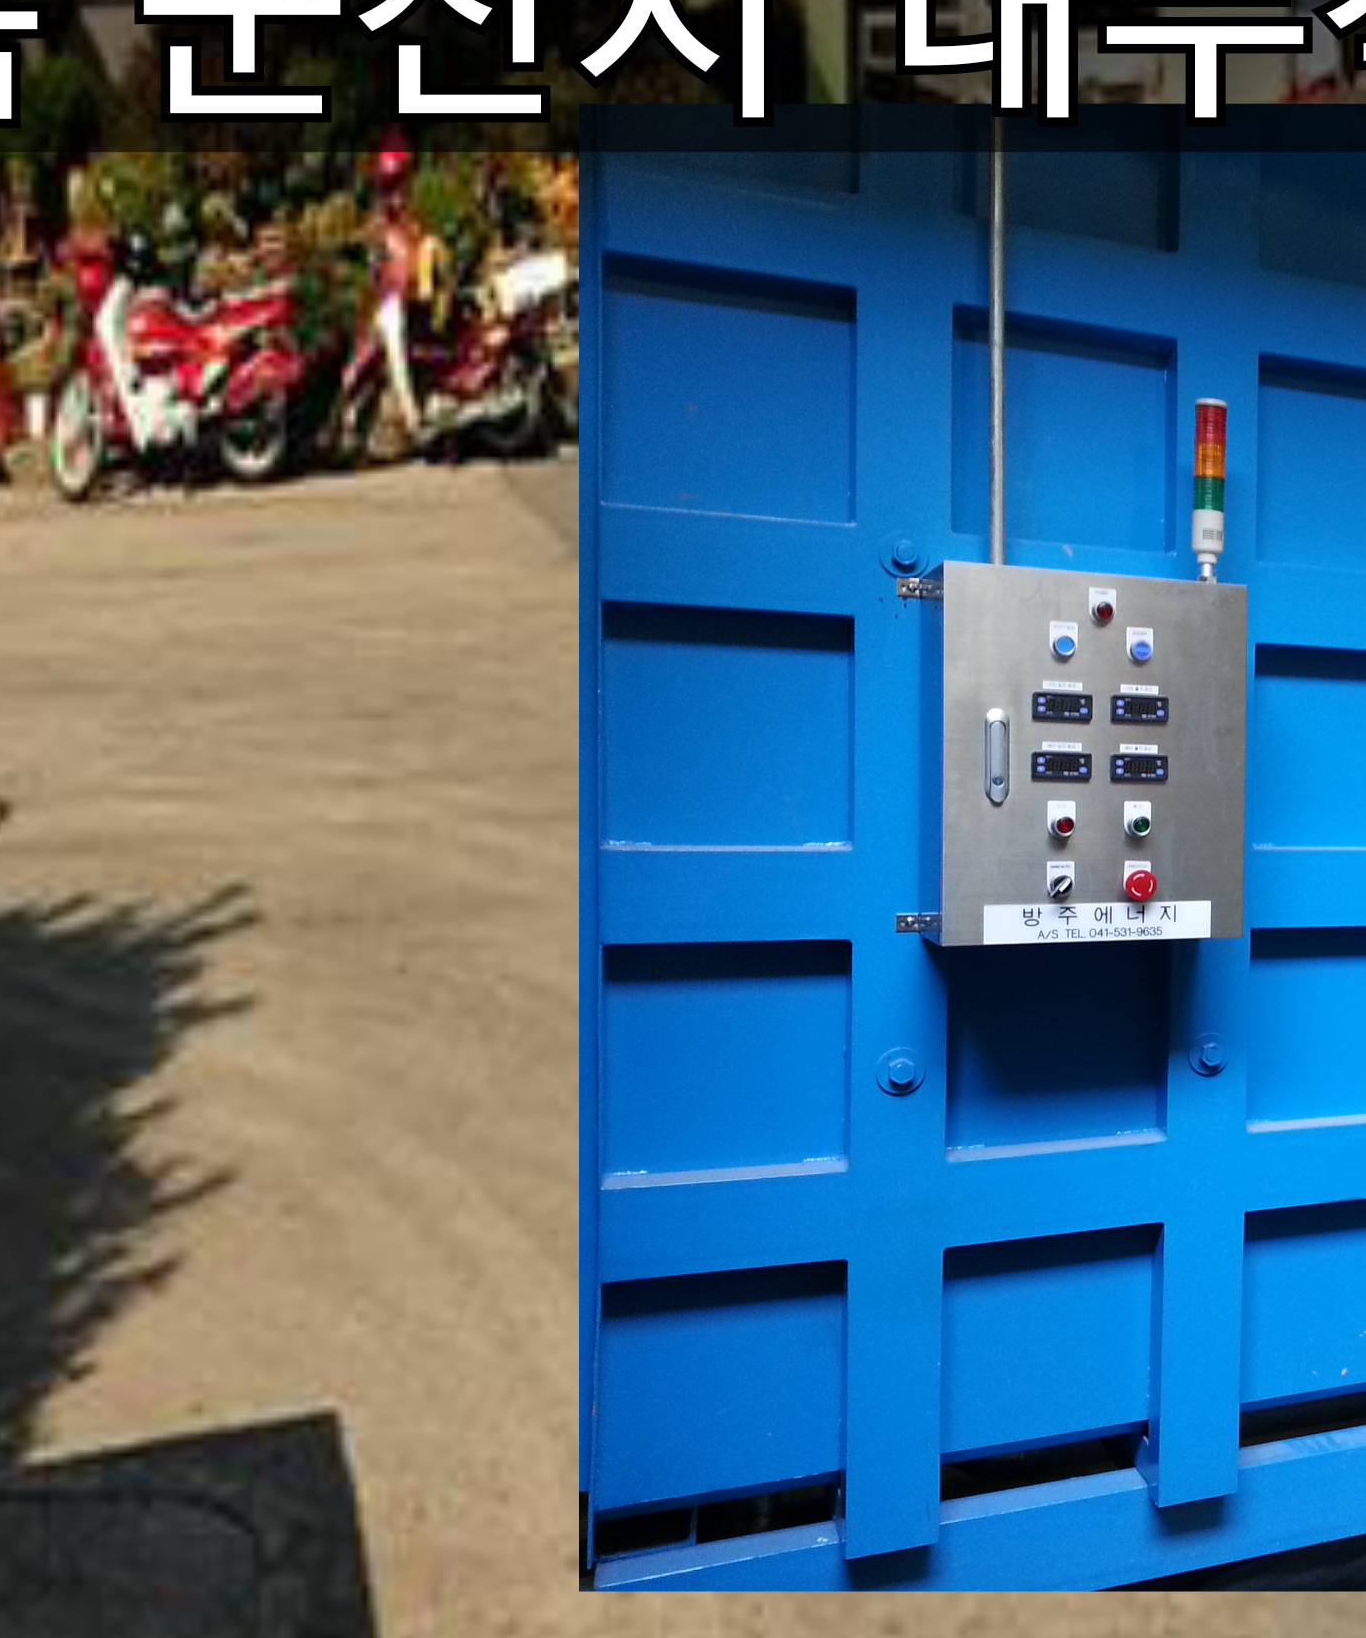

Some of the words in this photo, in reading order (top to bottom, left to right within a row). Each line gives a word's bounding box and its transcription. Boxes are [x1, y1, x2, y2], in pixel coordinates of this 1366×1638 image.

[1037, 930, 1059, 940] A/S
[1066, 928, 1086, 939] TEL.
[1089, 927, 1163, 938] 041-531-9635
